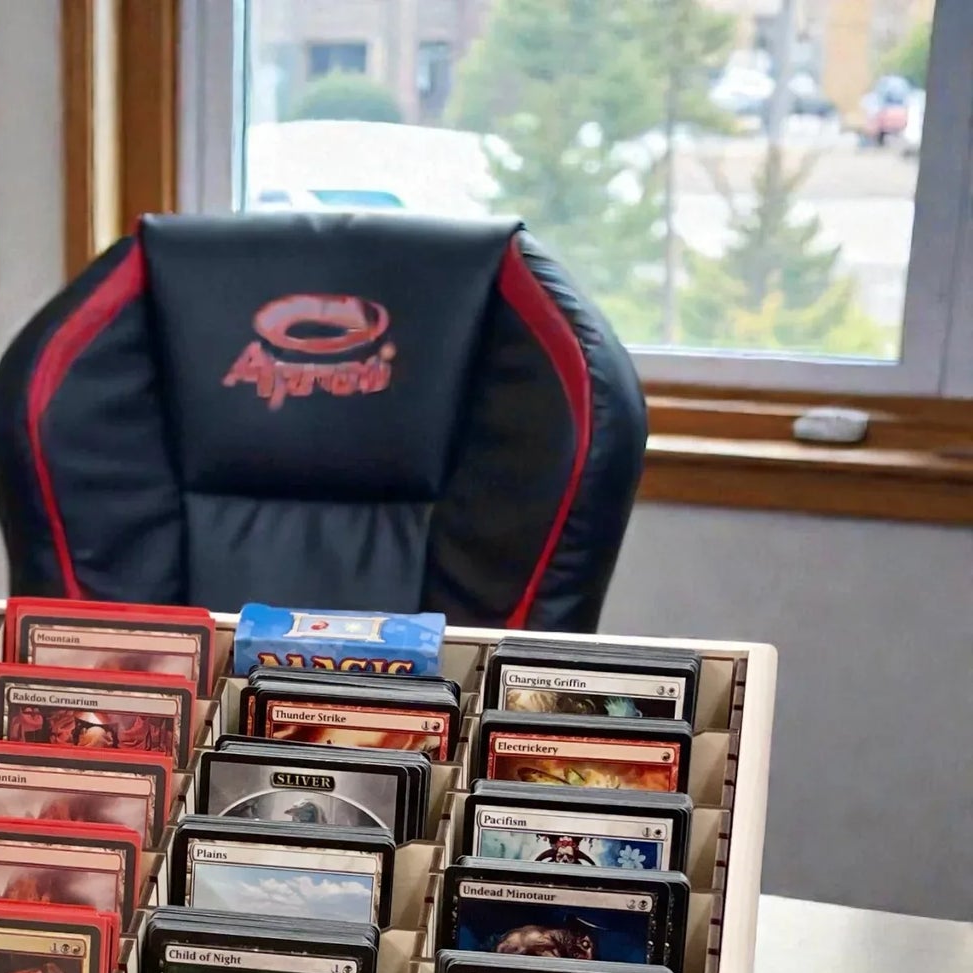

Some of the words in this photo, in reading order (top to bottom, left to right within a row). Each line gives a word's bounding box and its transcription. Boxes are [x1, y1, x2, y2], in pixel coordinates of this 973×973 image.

[37, 633, 80, 644] Mountain
[509, 675, 551, 687] Charging
[554, 679, 587, 689] Griffin
[12, 693, 47, 703] Rakdos
[49, 695, 98, 707] Carnarium
[275, 710, 315, 721] Thunder
[317, 713, 347, 724] Strike
[498, 743, 559, 755] Electrickery
[277, 774, 331, 788] SLIVER
[483, 815, 527, 826] Pacifism
[197, 849, 227, 860] Plains
[463, 885, 503, 898] Undead
[506, 890, 555, 902] Minotaur
[169, 950, 197, 961] Child
[199, 953, 212, 963] of
[214, 953, 241, 966] Night
